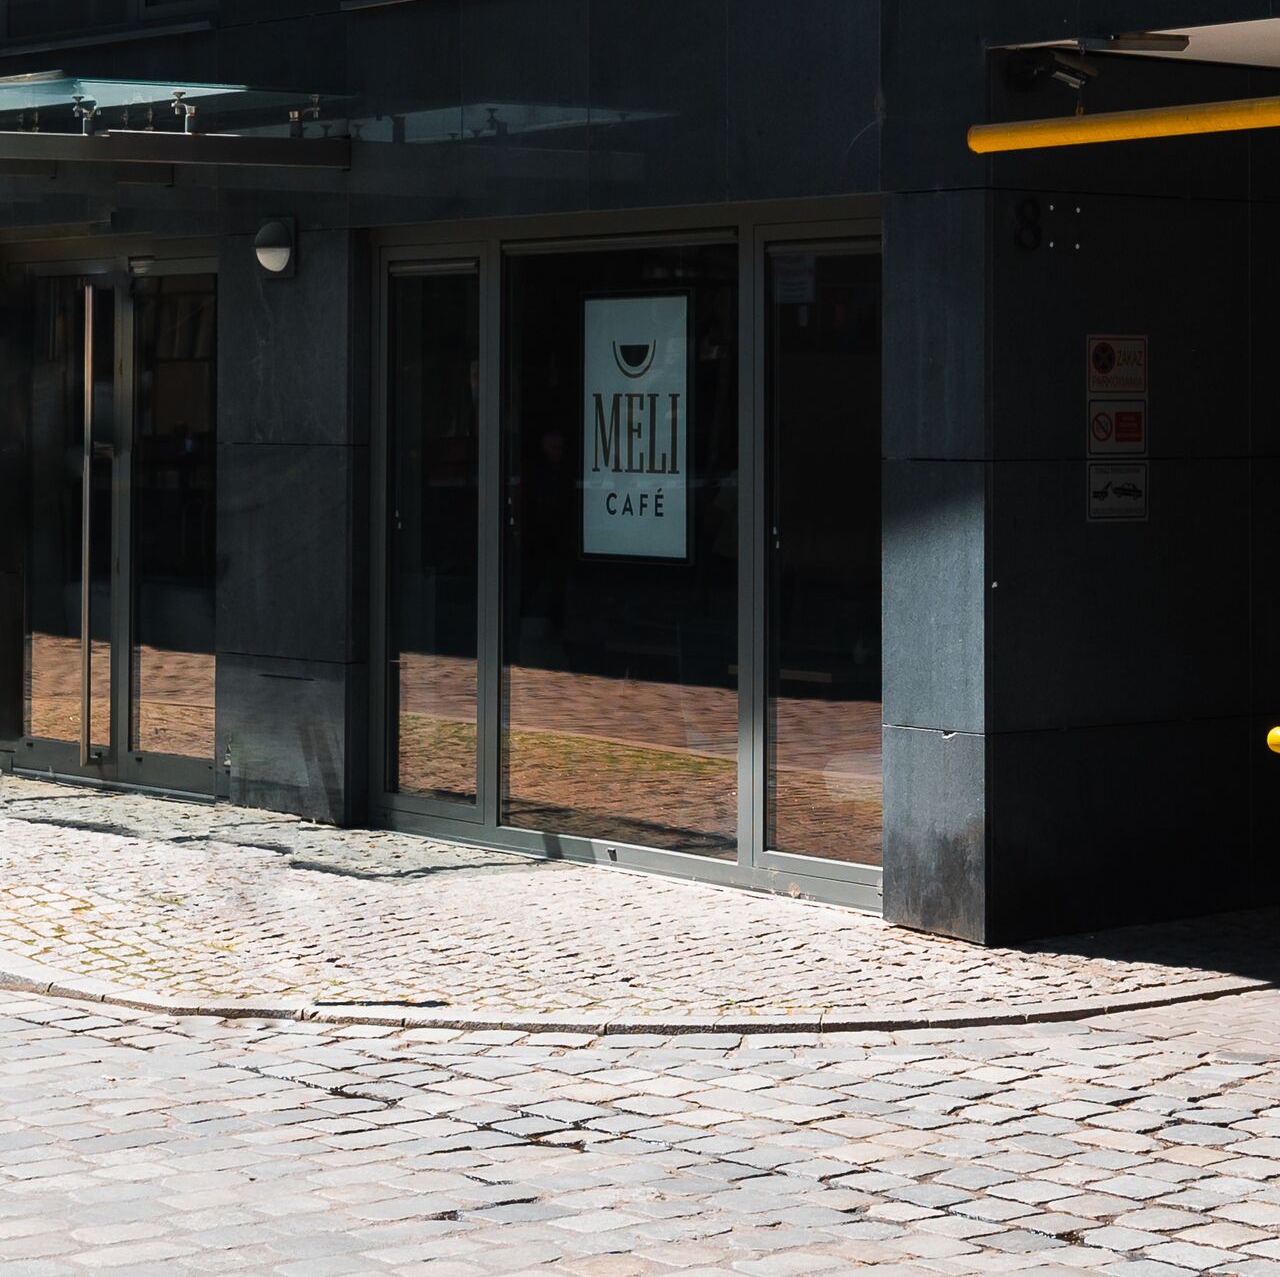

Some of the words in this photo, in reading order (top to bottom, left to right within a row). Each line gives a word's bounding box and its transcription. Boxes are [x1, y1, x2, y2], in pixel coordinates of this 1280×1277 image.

[1116, 349, 1143, 367] ZAKAZ
[592, 393, 680, 475] MELI
[606, 488, 664, 517] CAFÉ
